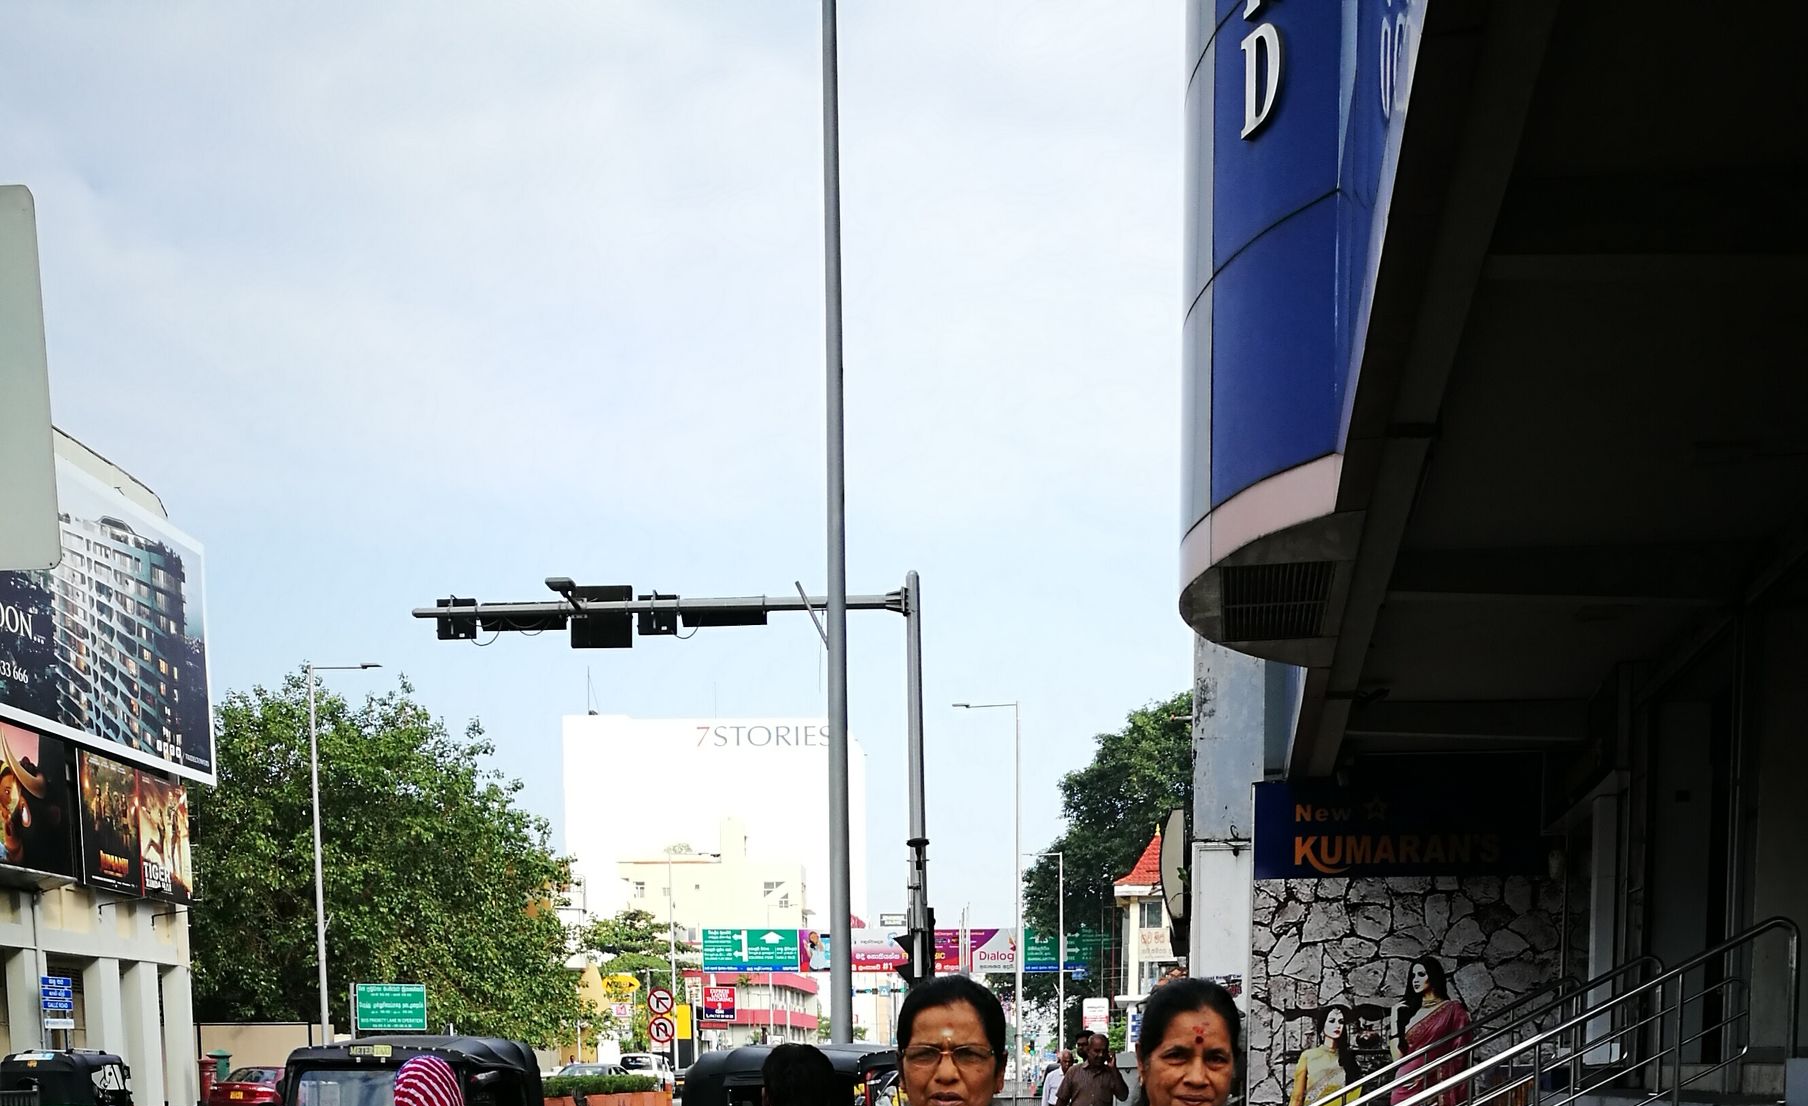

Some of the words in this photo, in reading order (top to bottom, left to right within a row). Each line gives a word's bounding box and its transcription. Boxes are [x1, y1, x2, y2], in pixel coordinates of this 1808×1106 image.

[1241, 0, 1281, 139] D
[13, 665, 29, 684] 666
[696, 725, 829, 747] 7STORIES
[1295, 804, 1351, 823] New
[1294, 831, 1500, 874] KUMARAN'S
[143, 861, 172, 883] TIGER
[979, 951, 1015, 962] Dialog
[349, 1046, 374, 1055] METER
